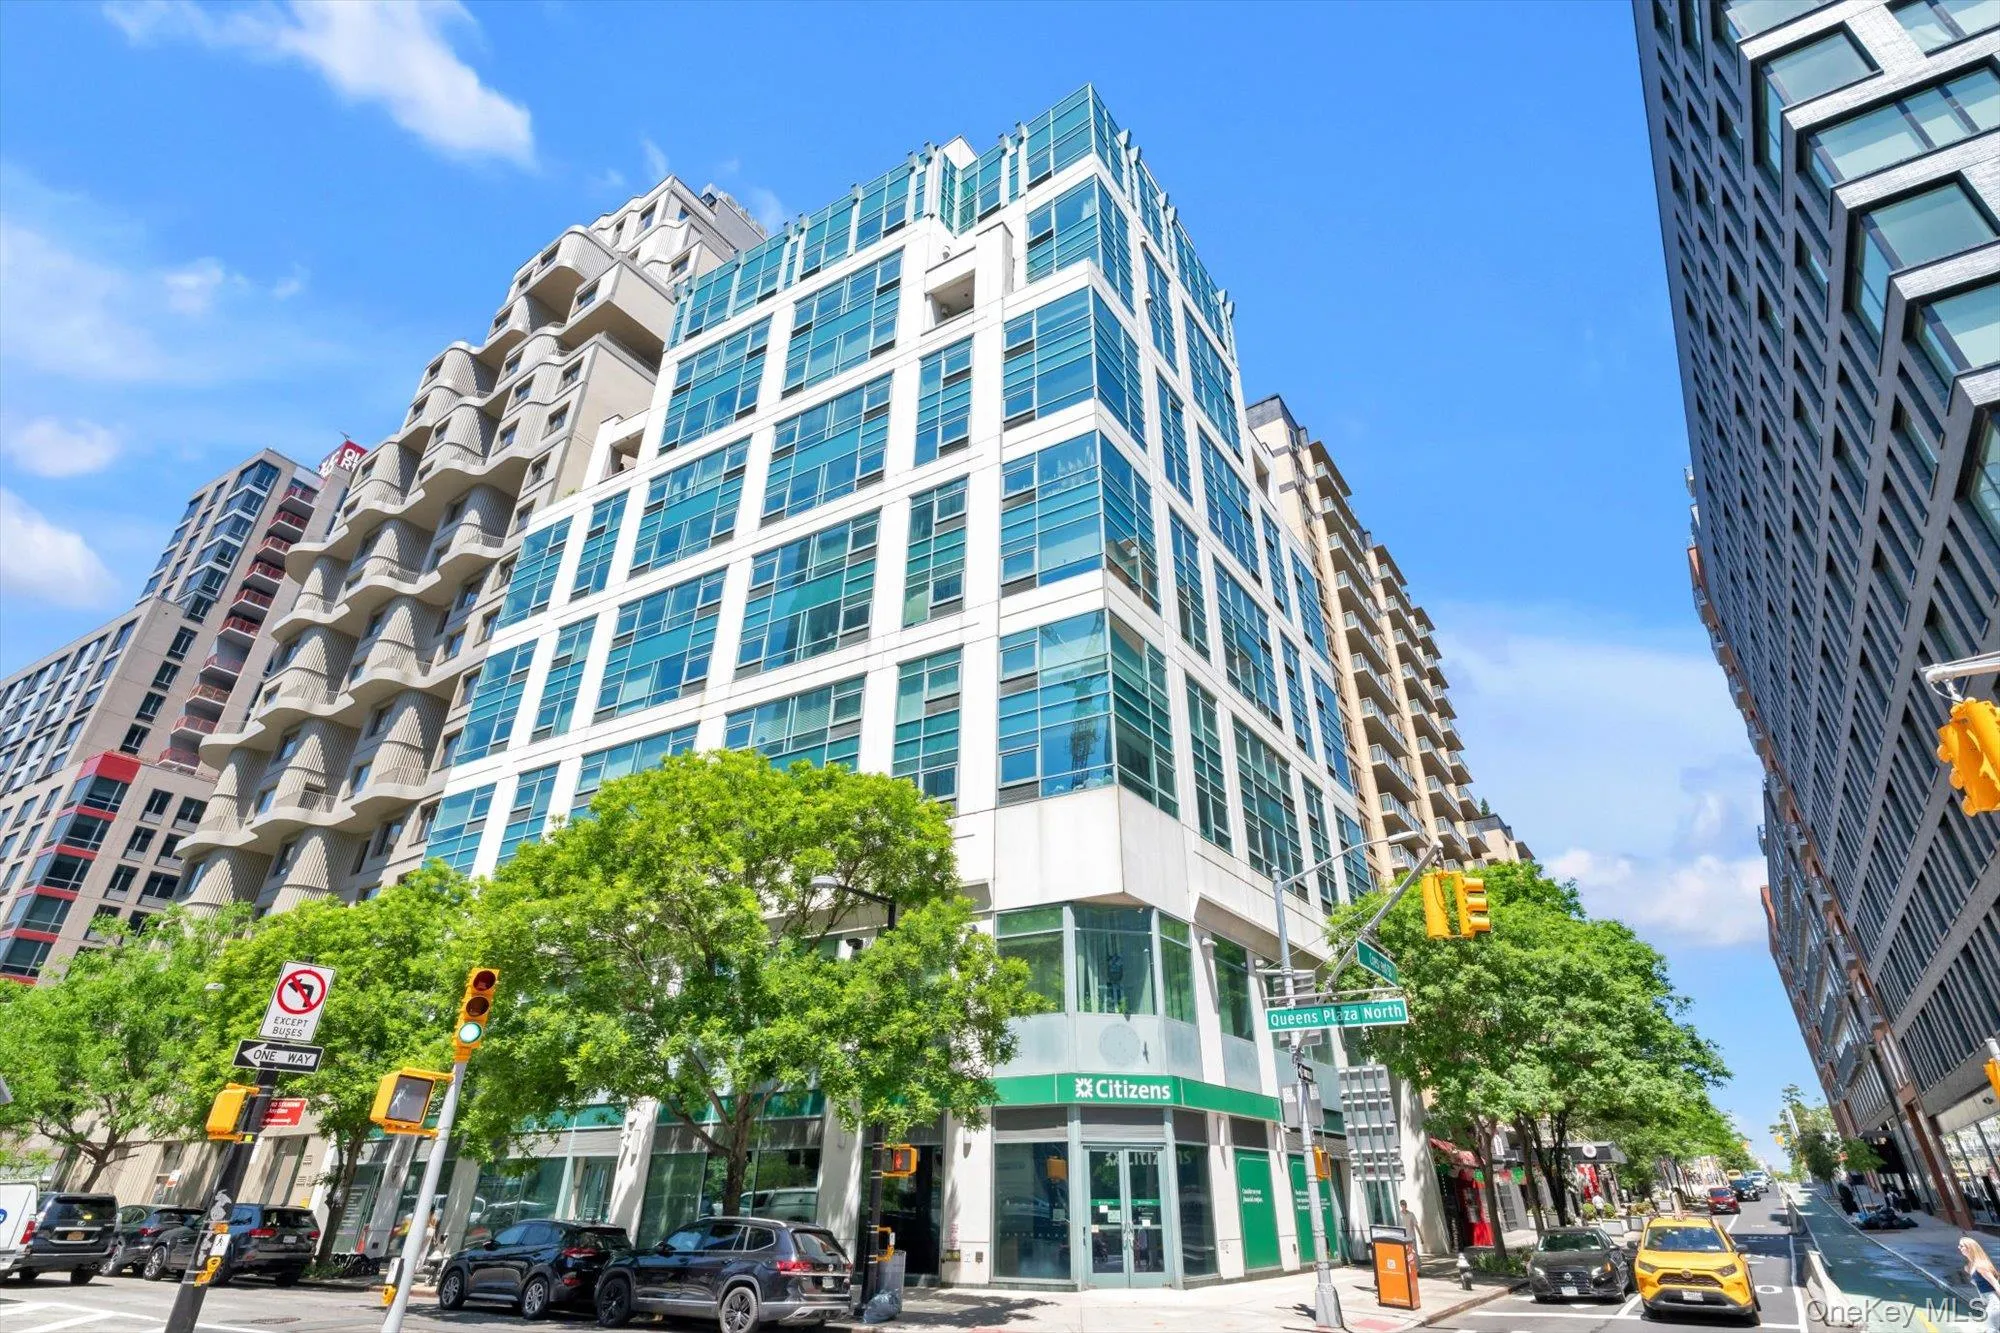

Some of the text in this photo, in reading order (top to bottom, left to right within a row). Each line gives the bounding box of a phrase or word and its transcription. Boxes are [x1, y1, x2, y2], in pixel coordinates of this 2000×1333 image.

[274, 1016, 309, 1027] EXCEPT
[1270, 1004, 1403, 1026] Queens Plaza North
[272, 1026, 303, 1037] BUSES
[253, 1049, 312, 1065] ONE WAY
[1096, 1079, 1171, 1099] Citizens
